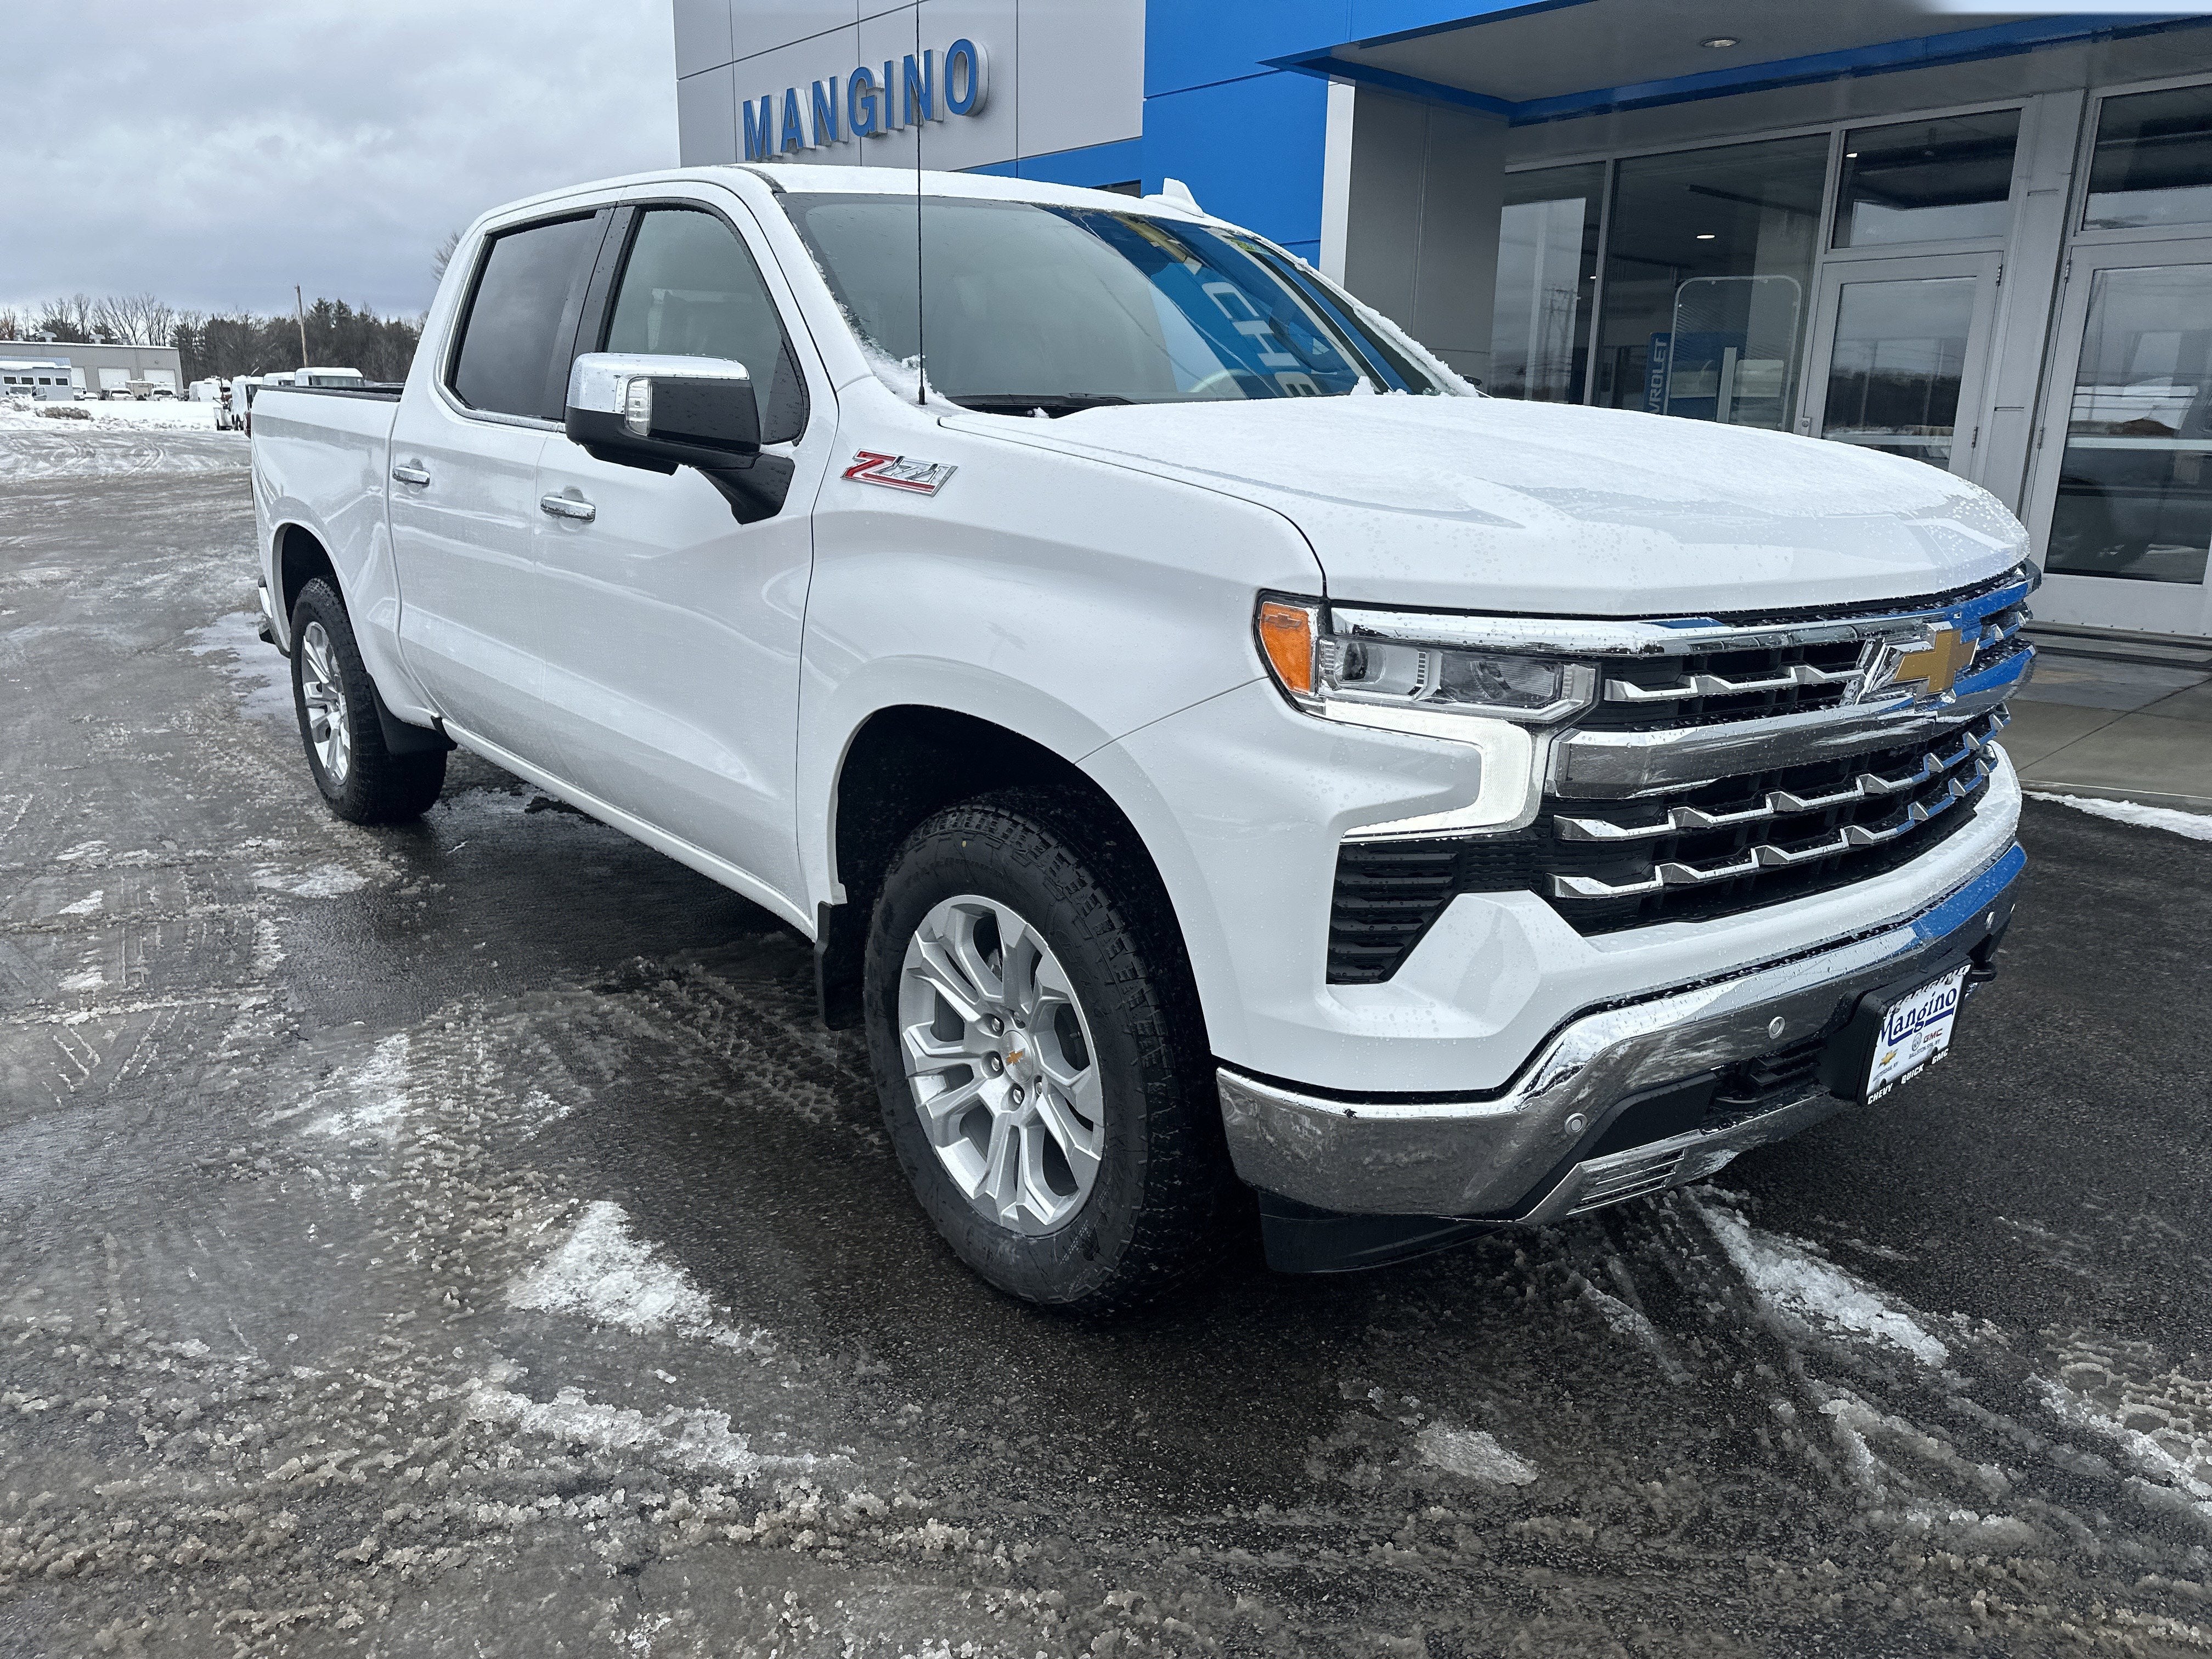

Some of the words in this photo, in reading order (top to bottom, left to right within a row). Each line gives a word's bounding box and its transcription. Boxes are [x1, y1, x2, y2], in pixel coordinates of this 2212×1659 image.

[743, 38, 989, 162] MANGINO
[840, 448, 958, 498] Z71
[1880, 988, 1957, 1047] Mangino
[1923, 1028, 1943, 1043] GMC
[1867, 1083, 1893, 1105] CHEVY
[1900, 1063, 1925, 1084] BUICK
[1932, 1048, 1949, 1065] GMC
